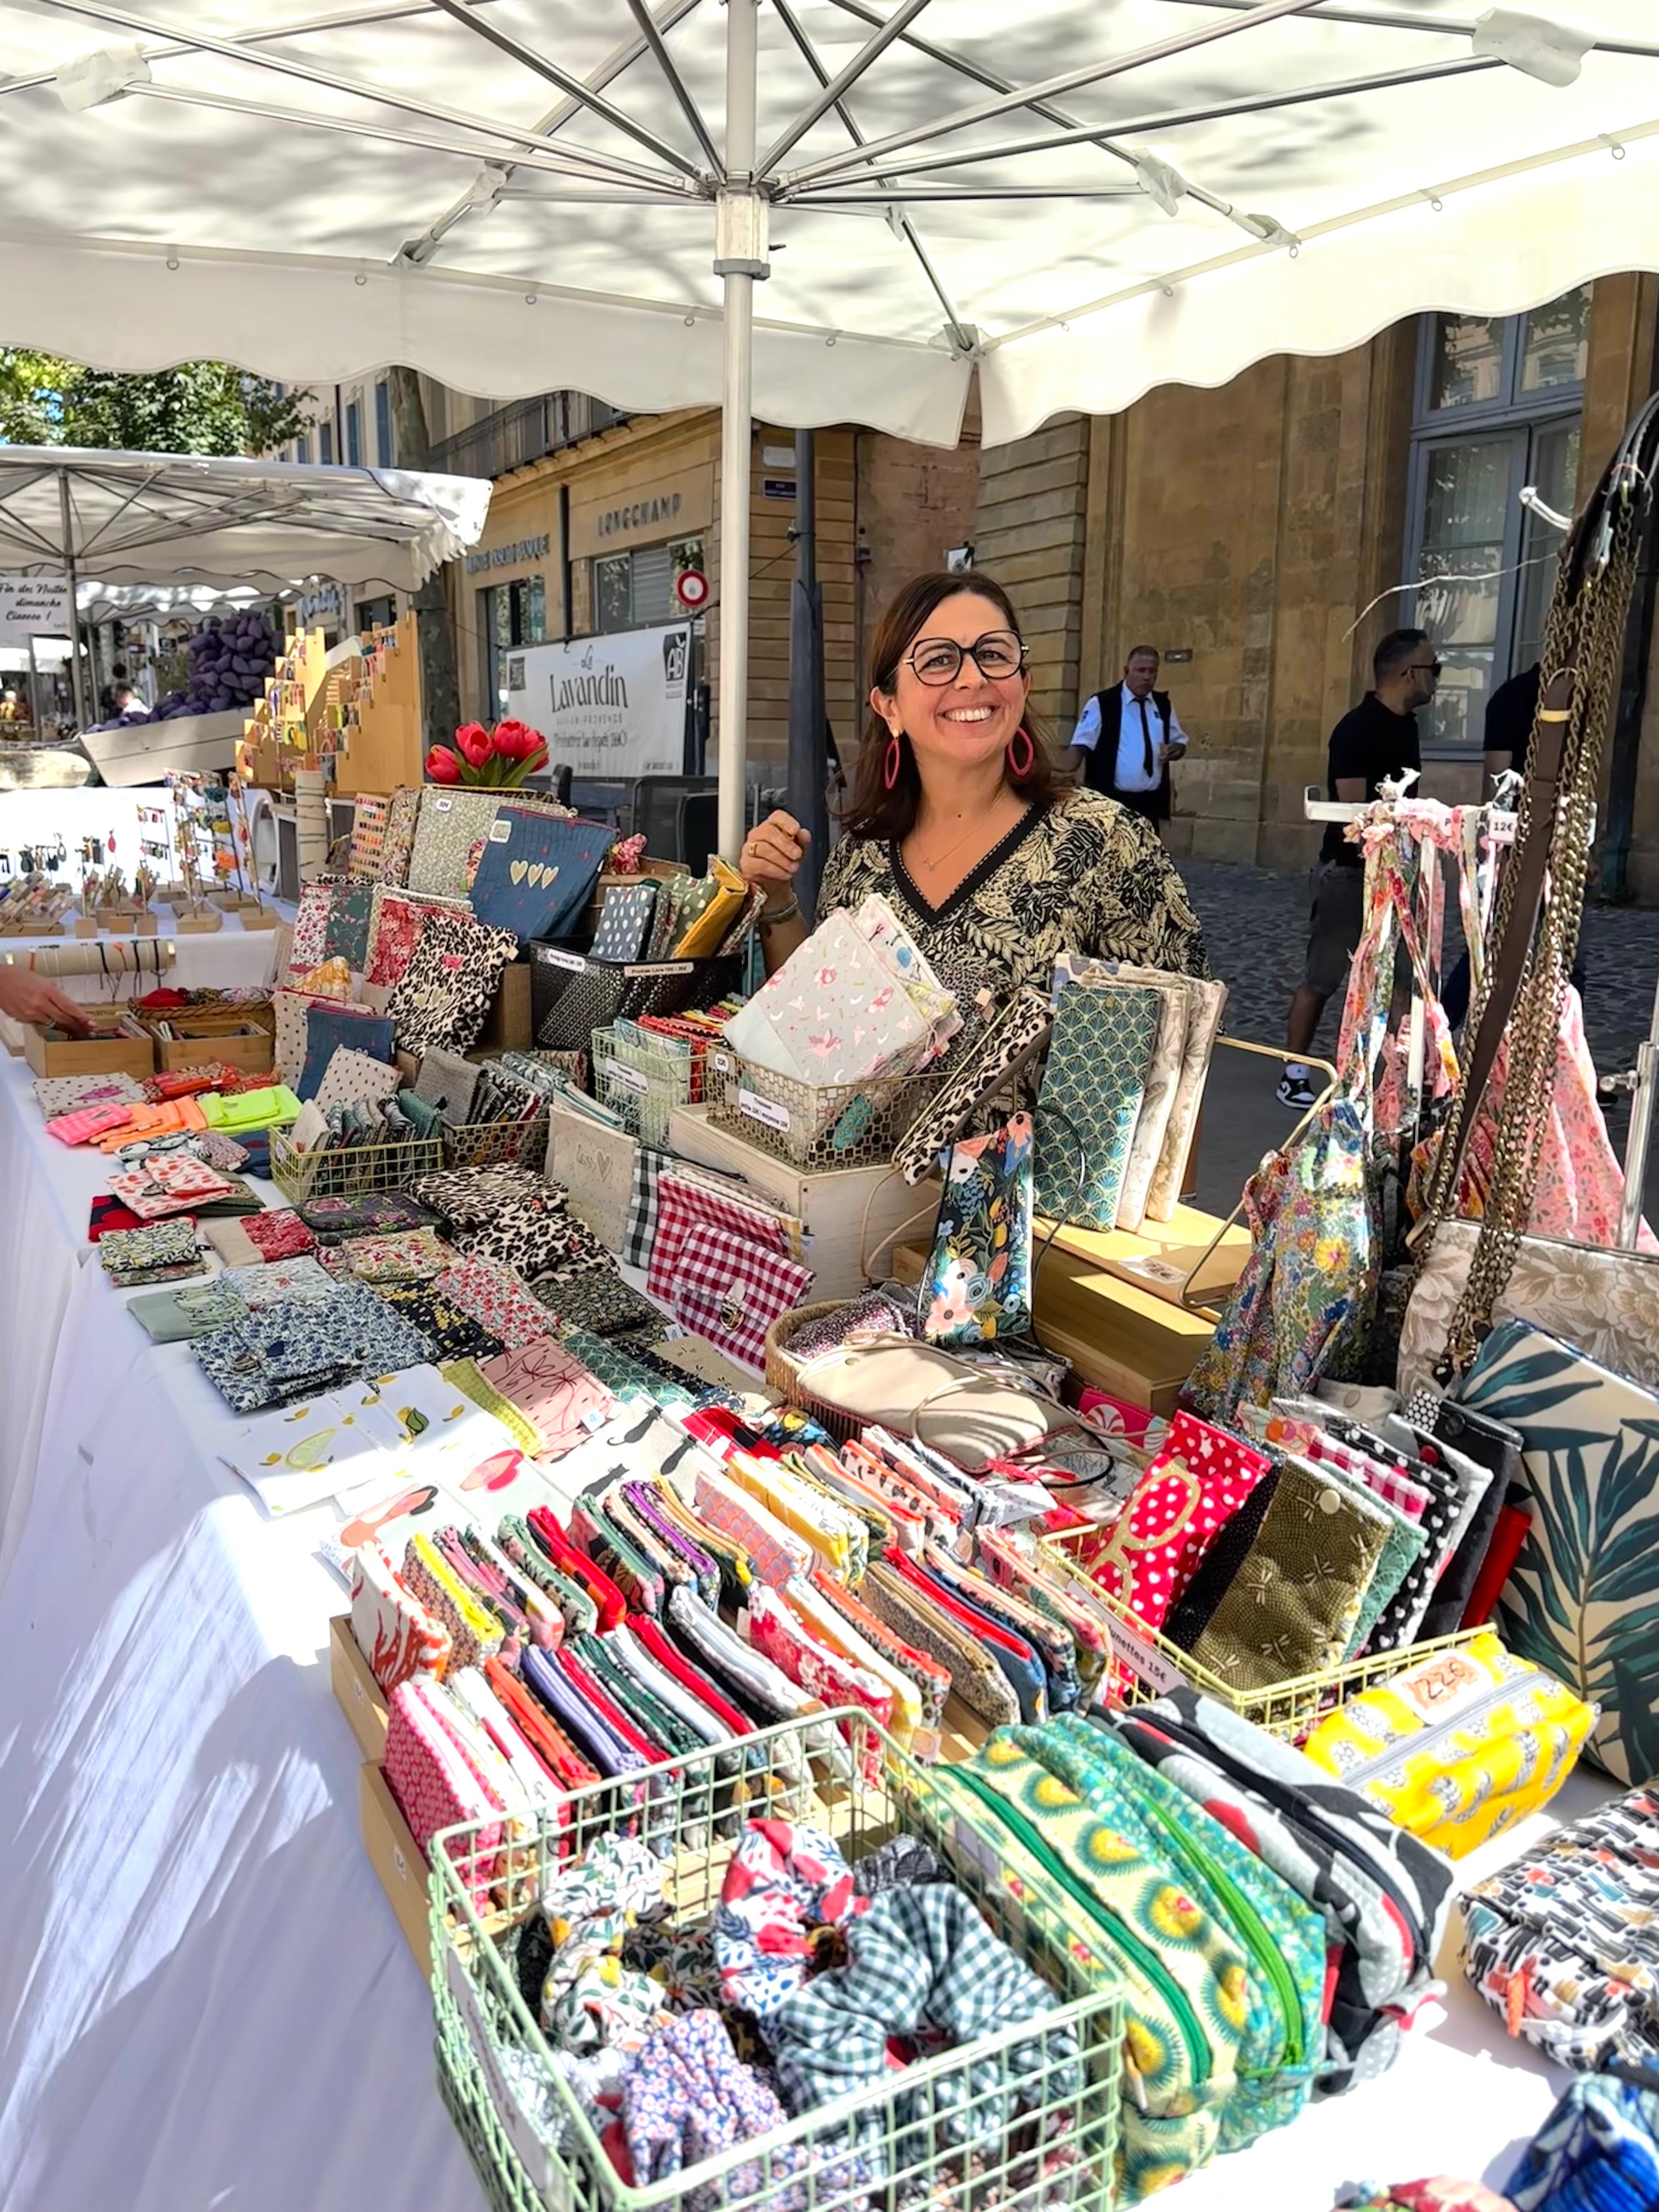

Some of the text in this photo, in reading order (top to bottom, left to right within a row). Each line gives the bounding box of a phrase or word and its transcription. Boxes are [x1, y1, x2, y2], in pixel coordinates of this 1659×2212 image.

[597, 492, 682, 538] LONGCHAMP
[667, 646, 685, 680] AB
[549, 663, 629, 714] Lavandin
[1493, 821, 1514, 832] 12€
[1147, 1661, 1167, 1683] 15€
[1414, 1661, 1465, 1700] 22€
